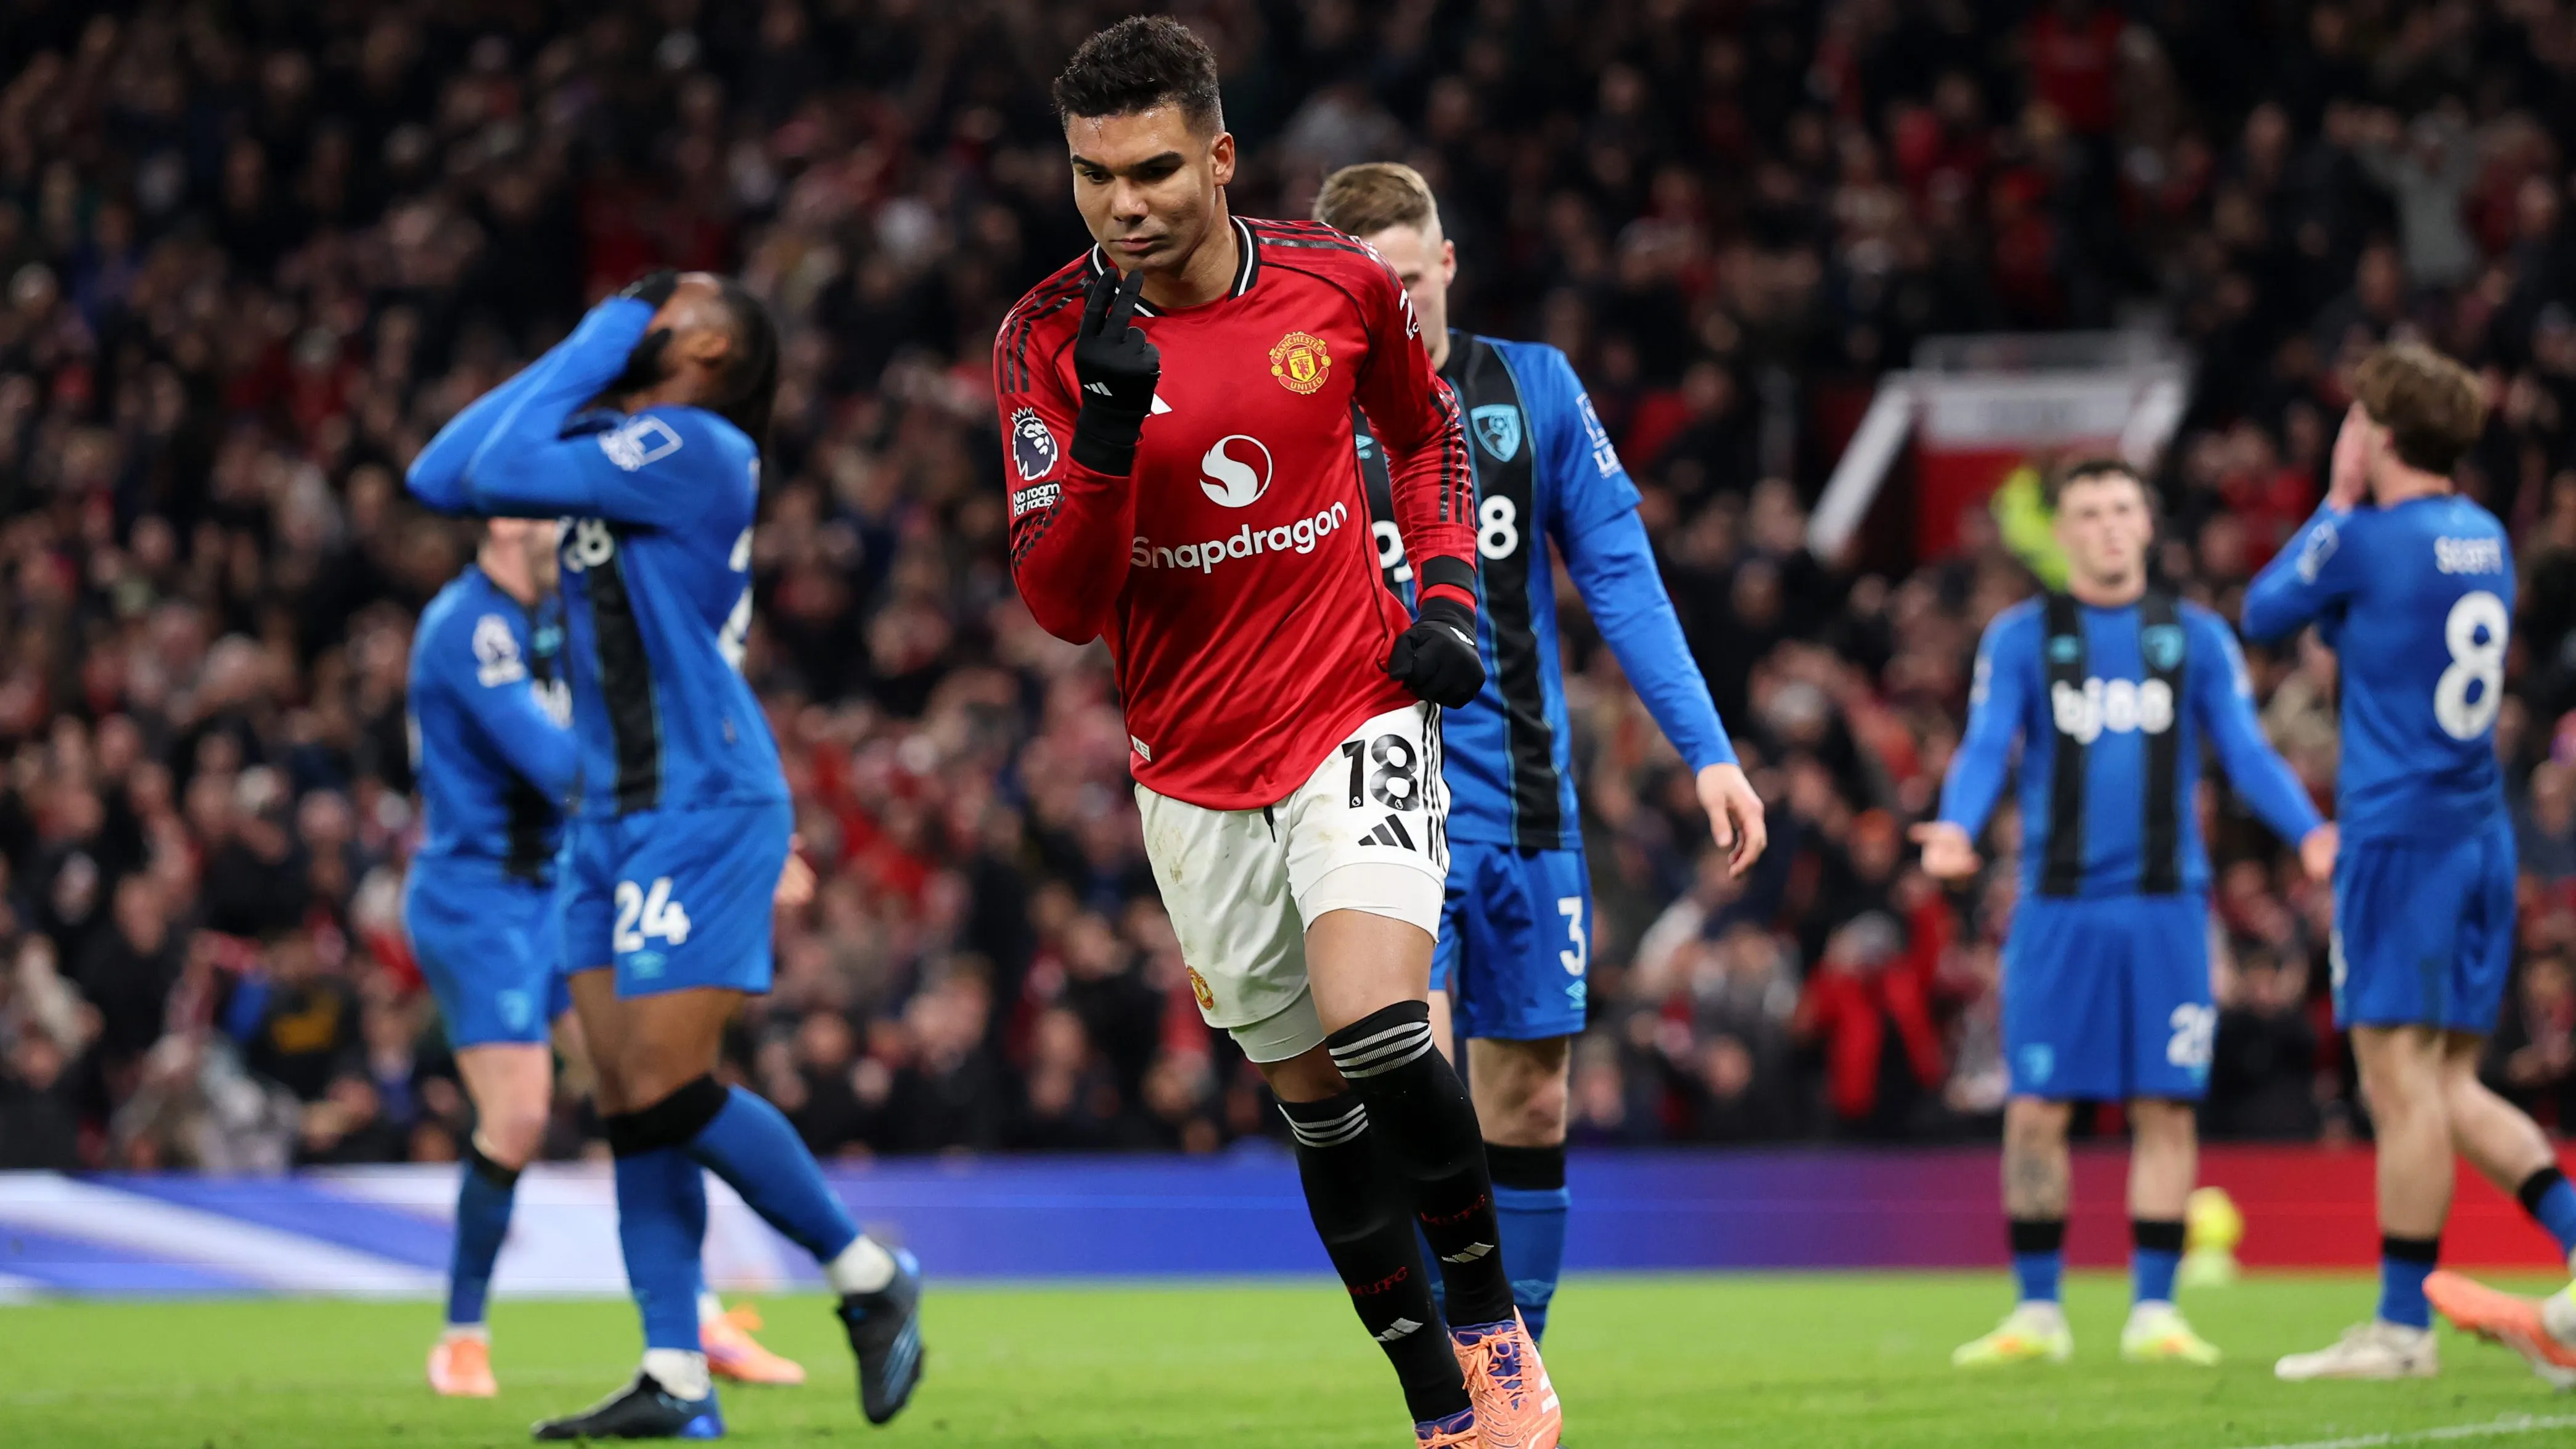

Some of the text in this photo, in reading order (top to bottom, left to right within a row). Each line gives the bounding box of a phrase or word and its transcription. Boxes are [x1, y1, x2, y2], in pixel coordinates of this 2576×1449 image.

[1274, 336, 1323, 360] MANCHESTER
[1290, 377, 1323, 390] UNITED
[1013, 483, 1060, 503] No room
[1014, 495, 1056, 517] for racis
[1130, 501, 1348, 574] Snapdragon
[2434, 590, 2509, 741] 8
[1342, 734, 1420, 812] 18
[613, 876, 692, 953] 24
[1557, 896, 1586, 977] 3
